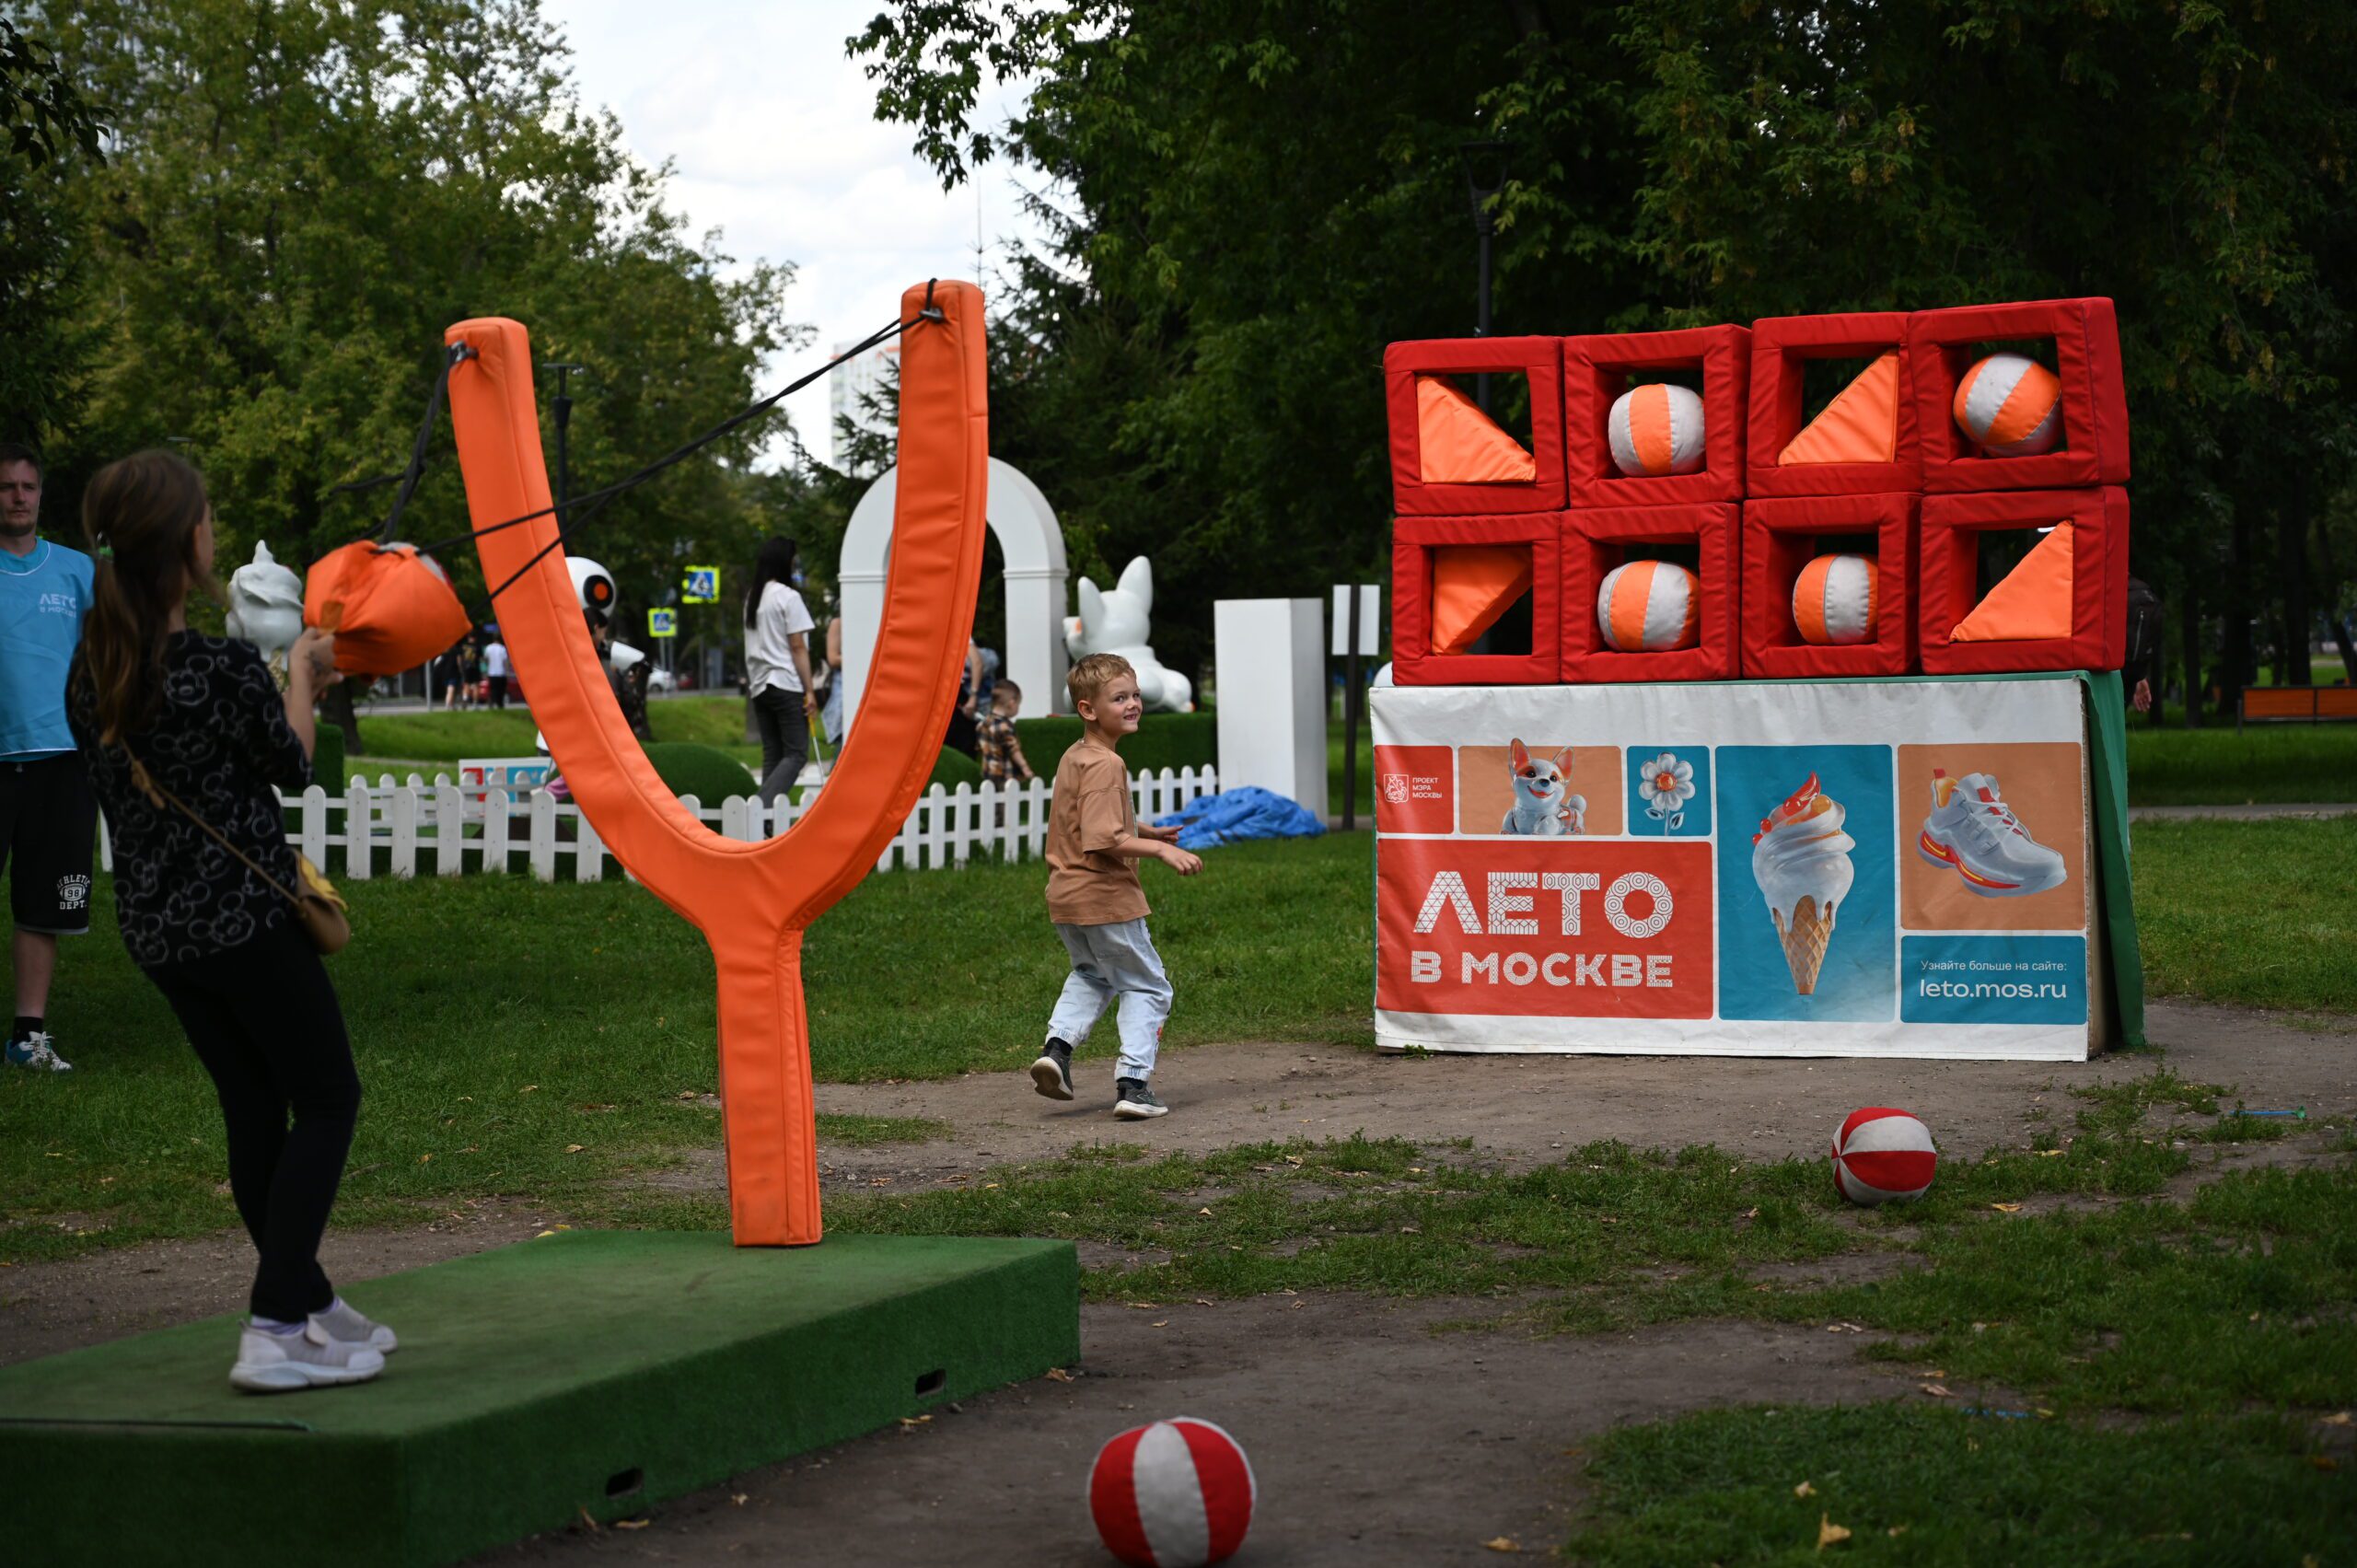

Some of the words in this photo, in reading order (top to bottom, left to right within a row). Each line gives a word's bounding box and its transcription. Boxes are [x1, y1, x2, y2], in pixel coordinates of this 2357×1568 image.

[67, 889, 80, 898] 98
[1412, 871, 1674, 939] ЛЕТО
[1411, 950, 1442, 983] В
[1461, 951, 1673, 987] МОСКВЕ
[1921, 960, 1966, 971] Узнайте
[1968, 960, 2012, 971] больше
[2014, 962, 2029, 971] на
[2031, 961, 2068, 971] сайте:
[1920, 979, 2067, 998] leto.mos.ru
